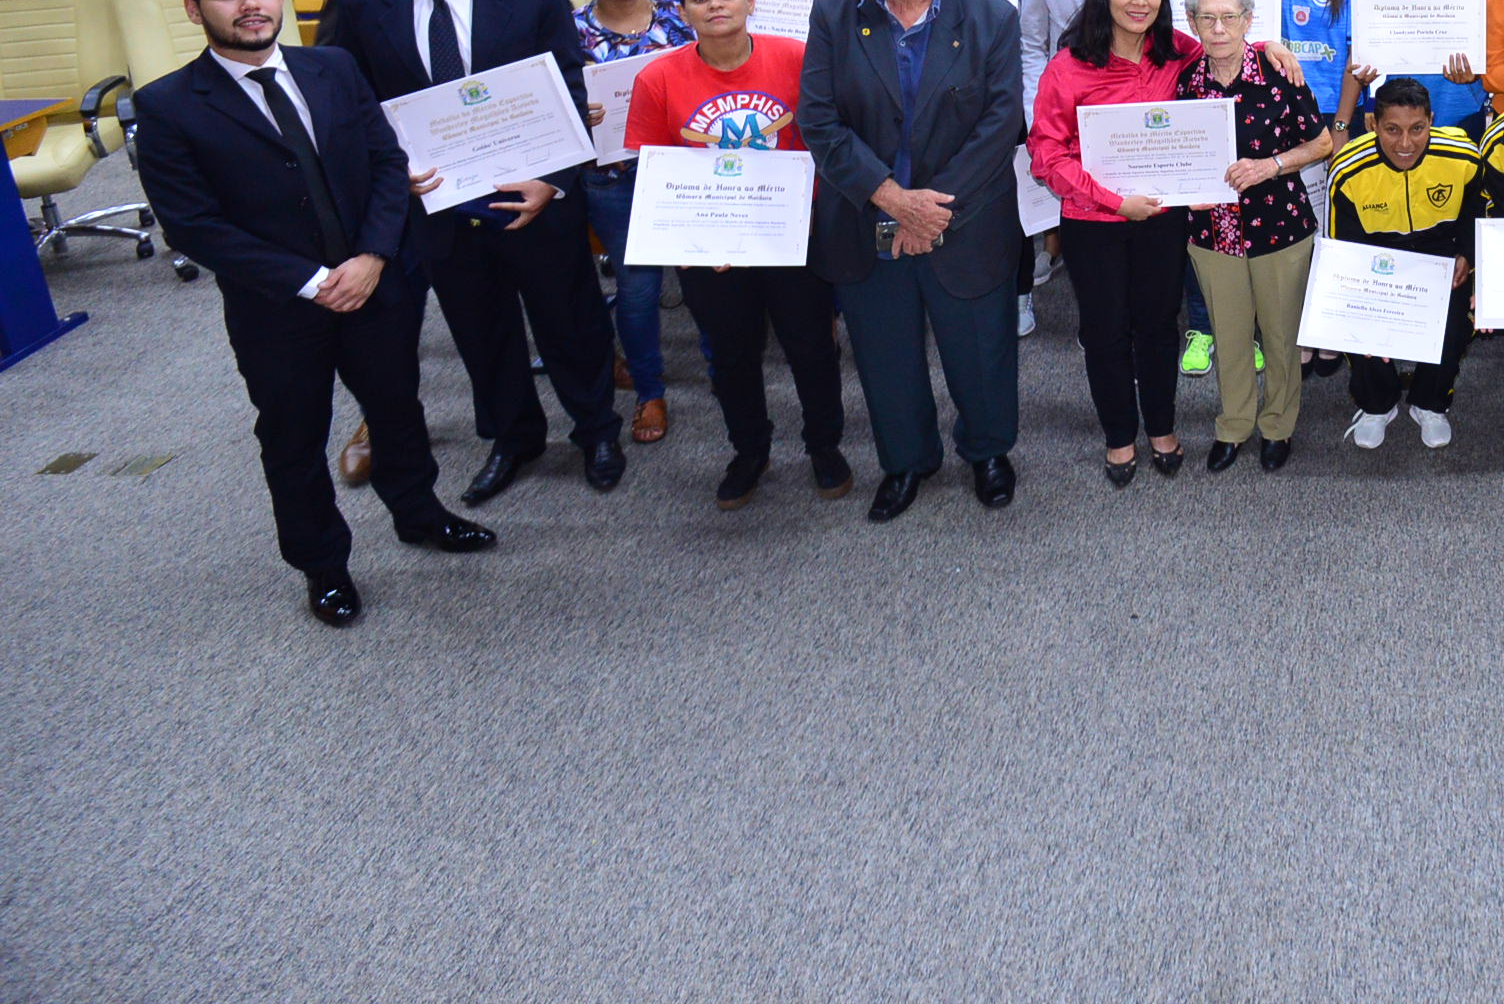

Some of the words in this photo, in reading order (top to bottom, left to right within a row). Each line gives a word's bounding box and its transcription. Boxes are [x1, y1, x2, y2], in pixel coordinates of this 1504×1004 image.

[690, 94, 784, 133] MEMPHIS
[666, 181, 700, 191] Diploma
[716, 183, 741, 192] Honra
[757, 183, 785, 192] Mérito
[1363, 202, 1387, 211] ALIANÇA
